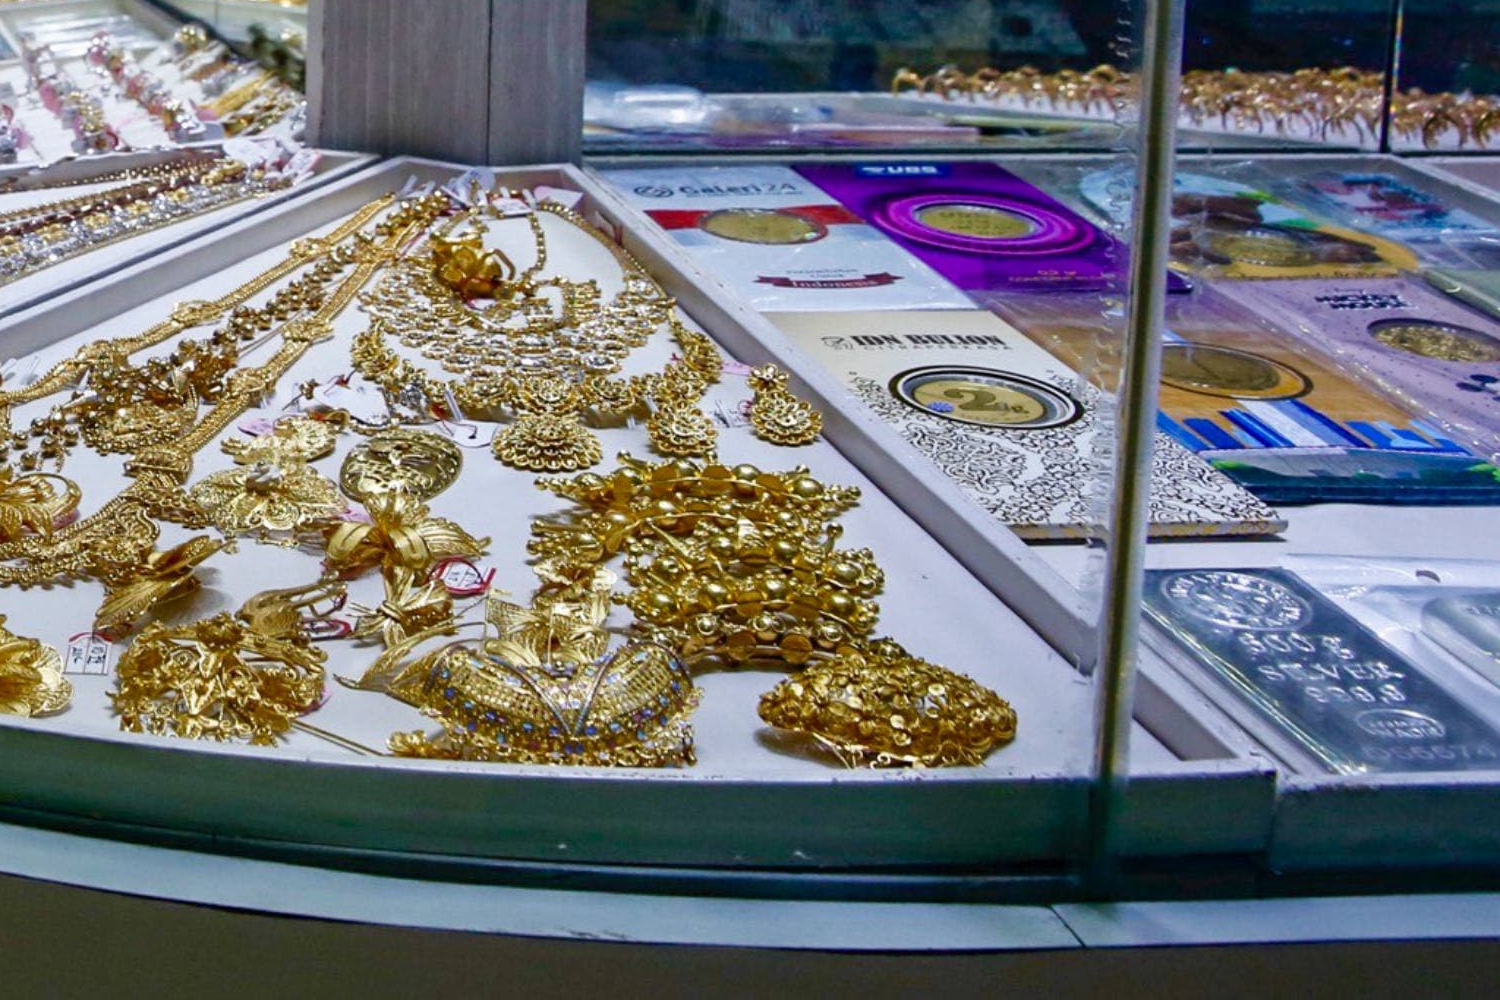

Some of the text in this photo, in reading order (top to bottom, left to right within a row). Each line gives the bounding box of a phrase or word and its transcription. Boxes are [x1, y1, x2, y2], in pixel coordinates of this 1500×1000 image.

[850, 334, 902, 347] IDN
[943, 387, 1000, 412] 2
[1257, 662, 1407, 681] SILVER
